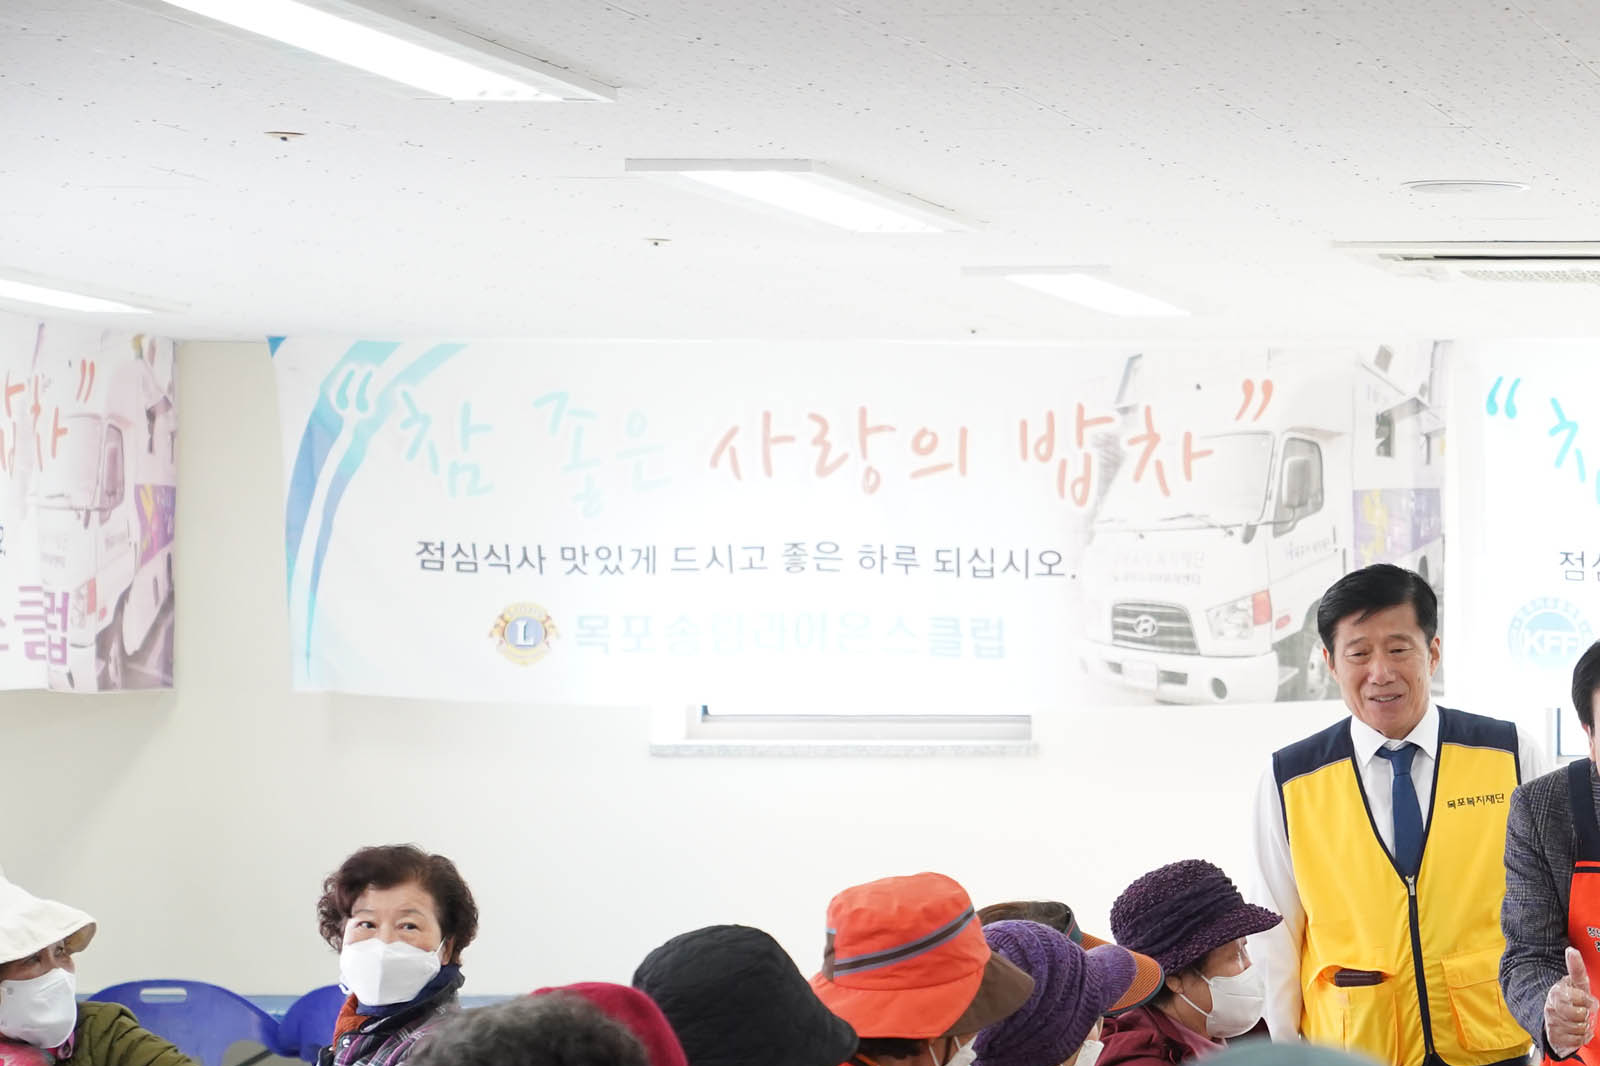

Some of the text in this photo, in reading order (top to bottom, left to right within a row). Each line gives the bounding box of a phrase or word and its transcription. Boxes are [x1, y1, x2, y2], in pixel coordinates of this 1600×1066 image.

[532, 390, 673, 518] 좋은
[710, 405, 969, 496] 사랑의
[414, 540, 547, 576] 점심식사
[560, 546, 657, 577] 맛있게
[670, 545, 768, 574] 드시고
[782, 541, 844, 574] 좋은
[857, 544, 921, 577] 하루
[933, 546, 1078, 581] 되십시오.
[1446, 793, 1505, 809] 목포복지재단
